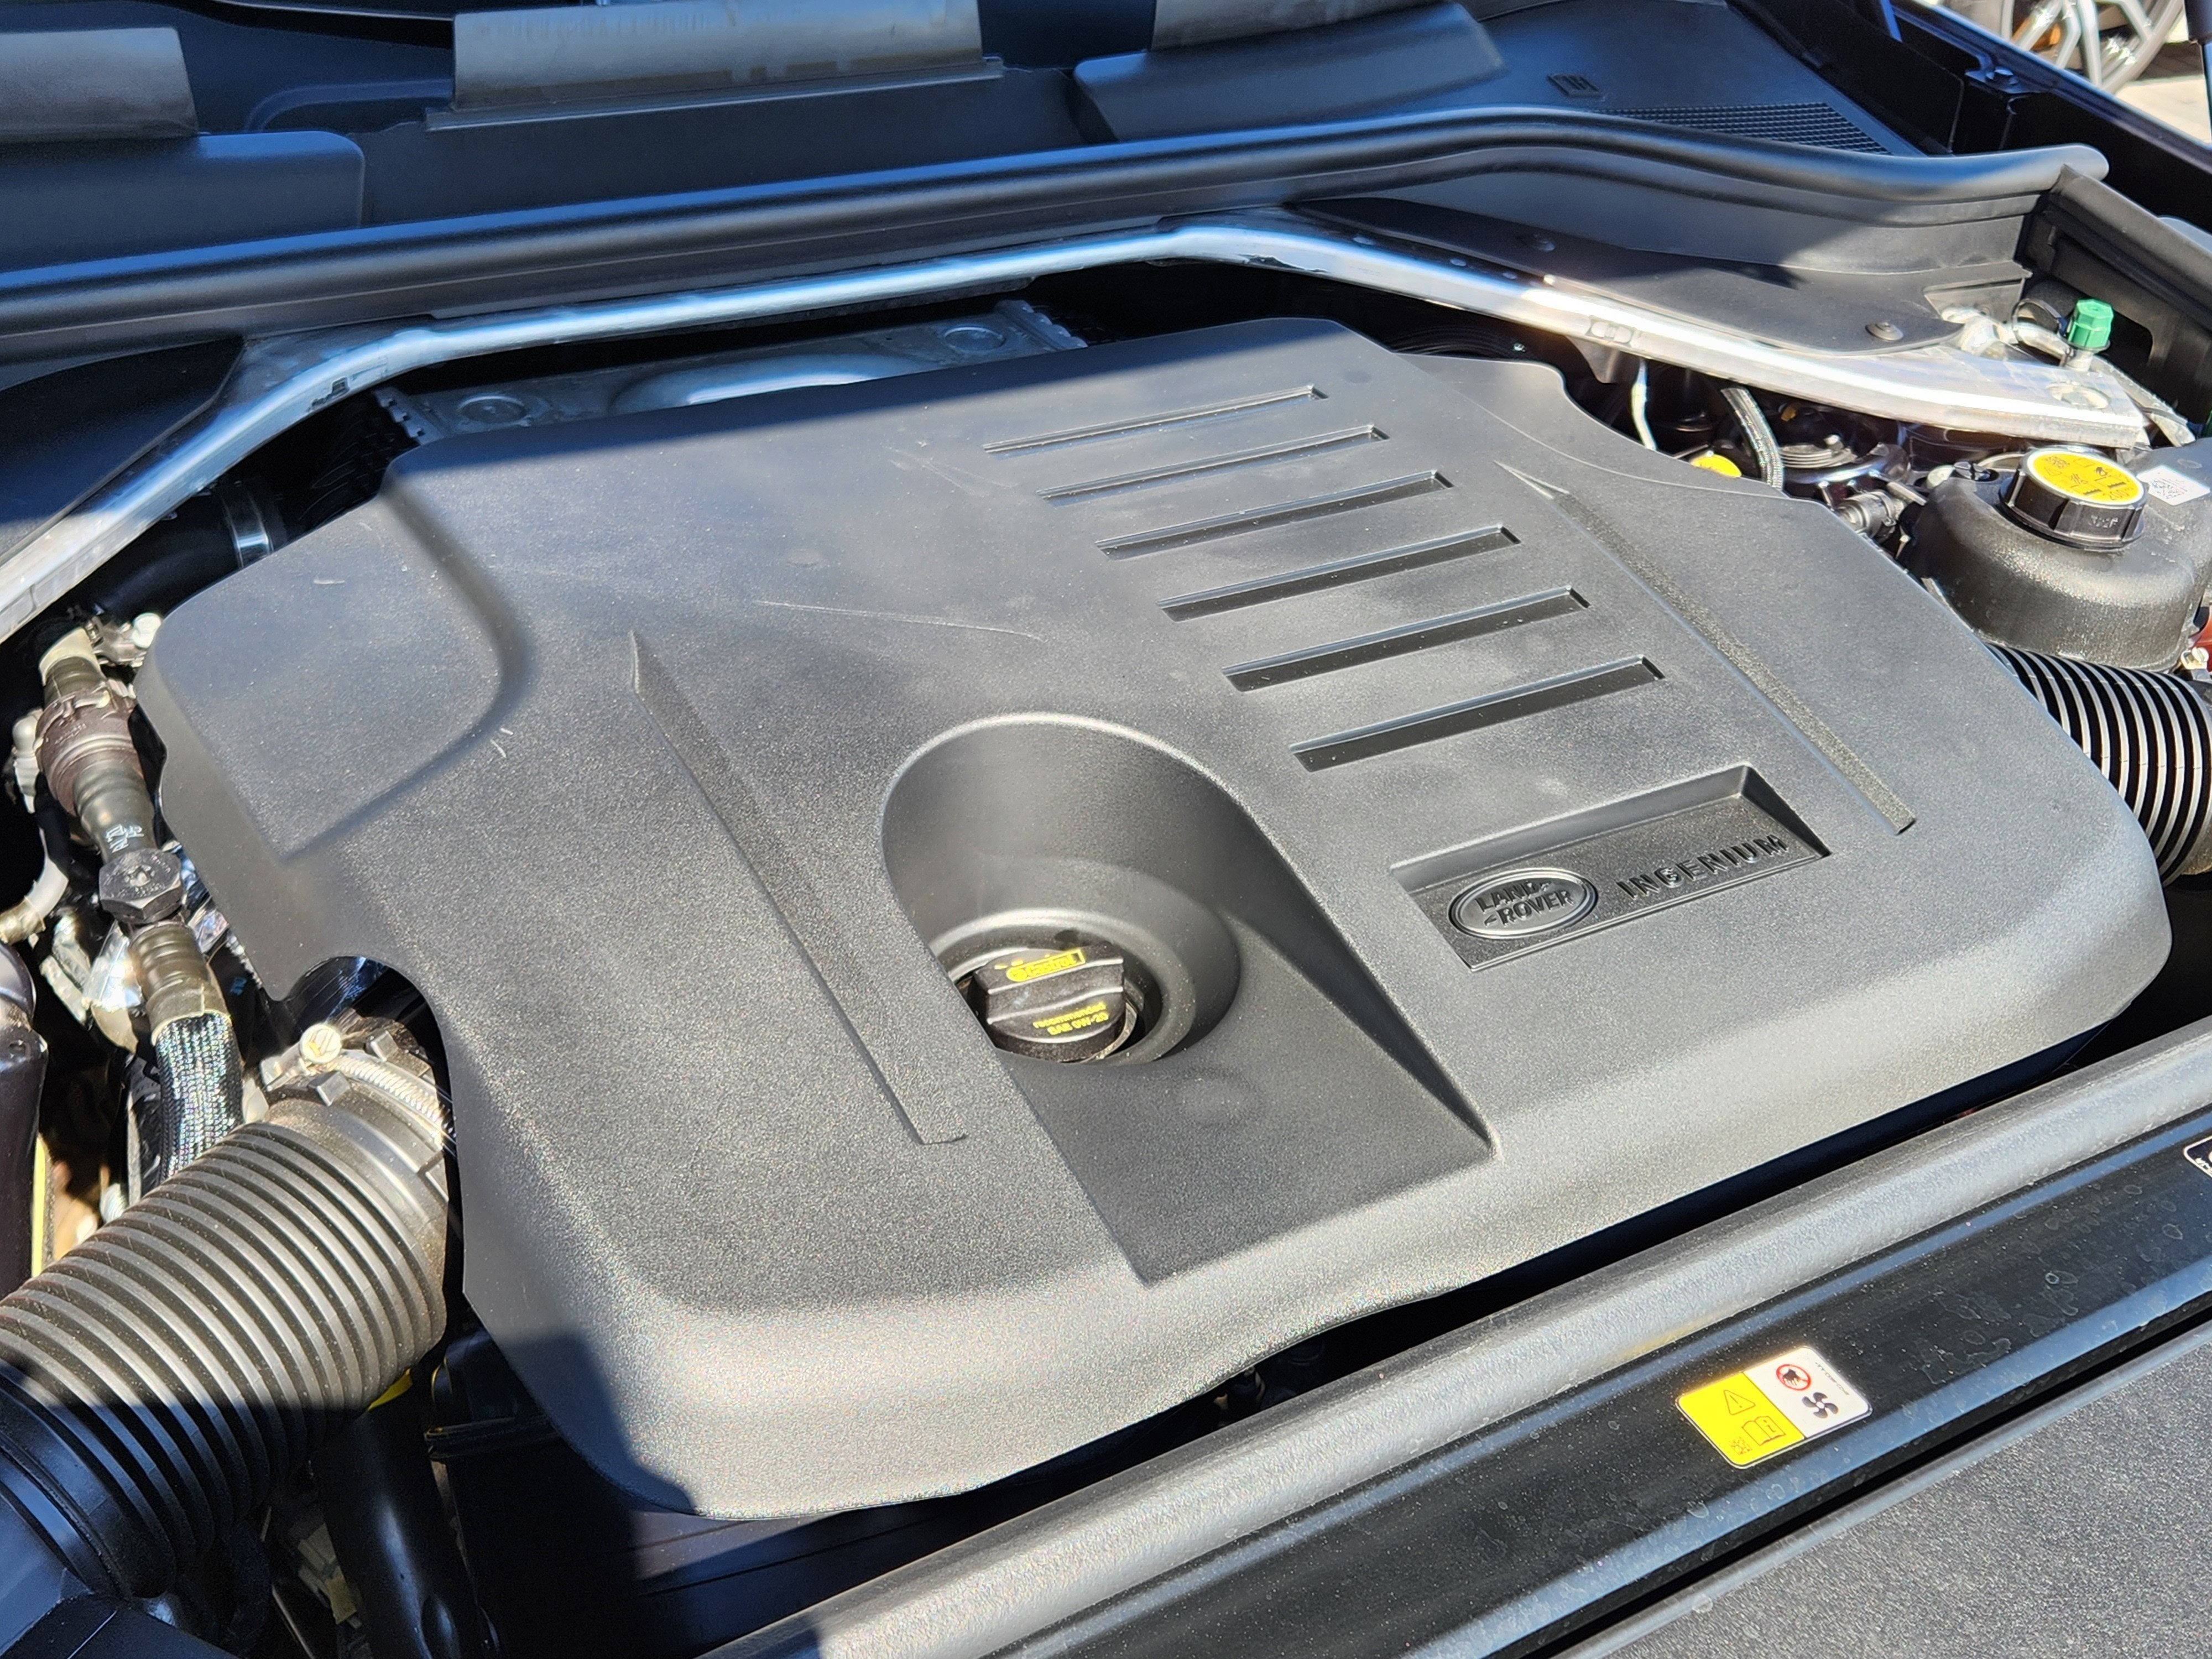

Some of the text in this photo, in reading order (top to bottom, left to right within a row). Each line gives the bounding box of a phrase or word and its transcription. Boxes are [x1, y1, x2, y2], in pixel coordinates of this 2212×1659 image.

[1616, 834, 1790, 900] INGENIUM
[1475, 880, 1540, 914] LAND
[1496, 889, 1574, 927] ROVER
[1024, 953, 1078, 979] Castrol
[1032, 1002, 1106, 1029] recommended
[1047, 1022, 1073, 1036] SAE
